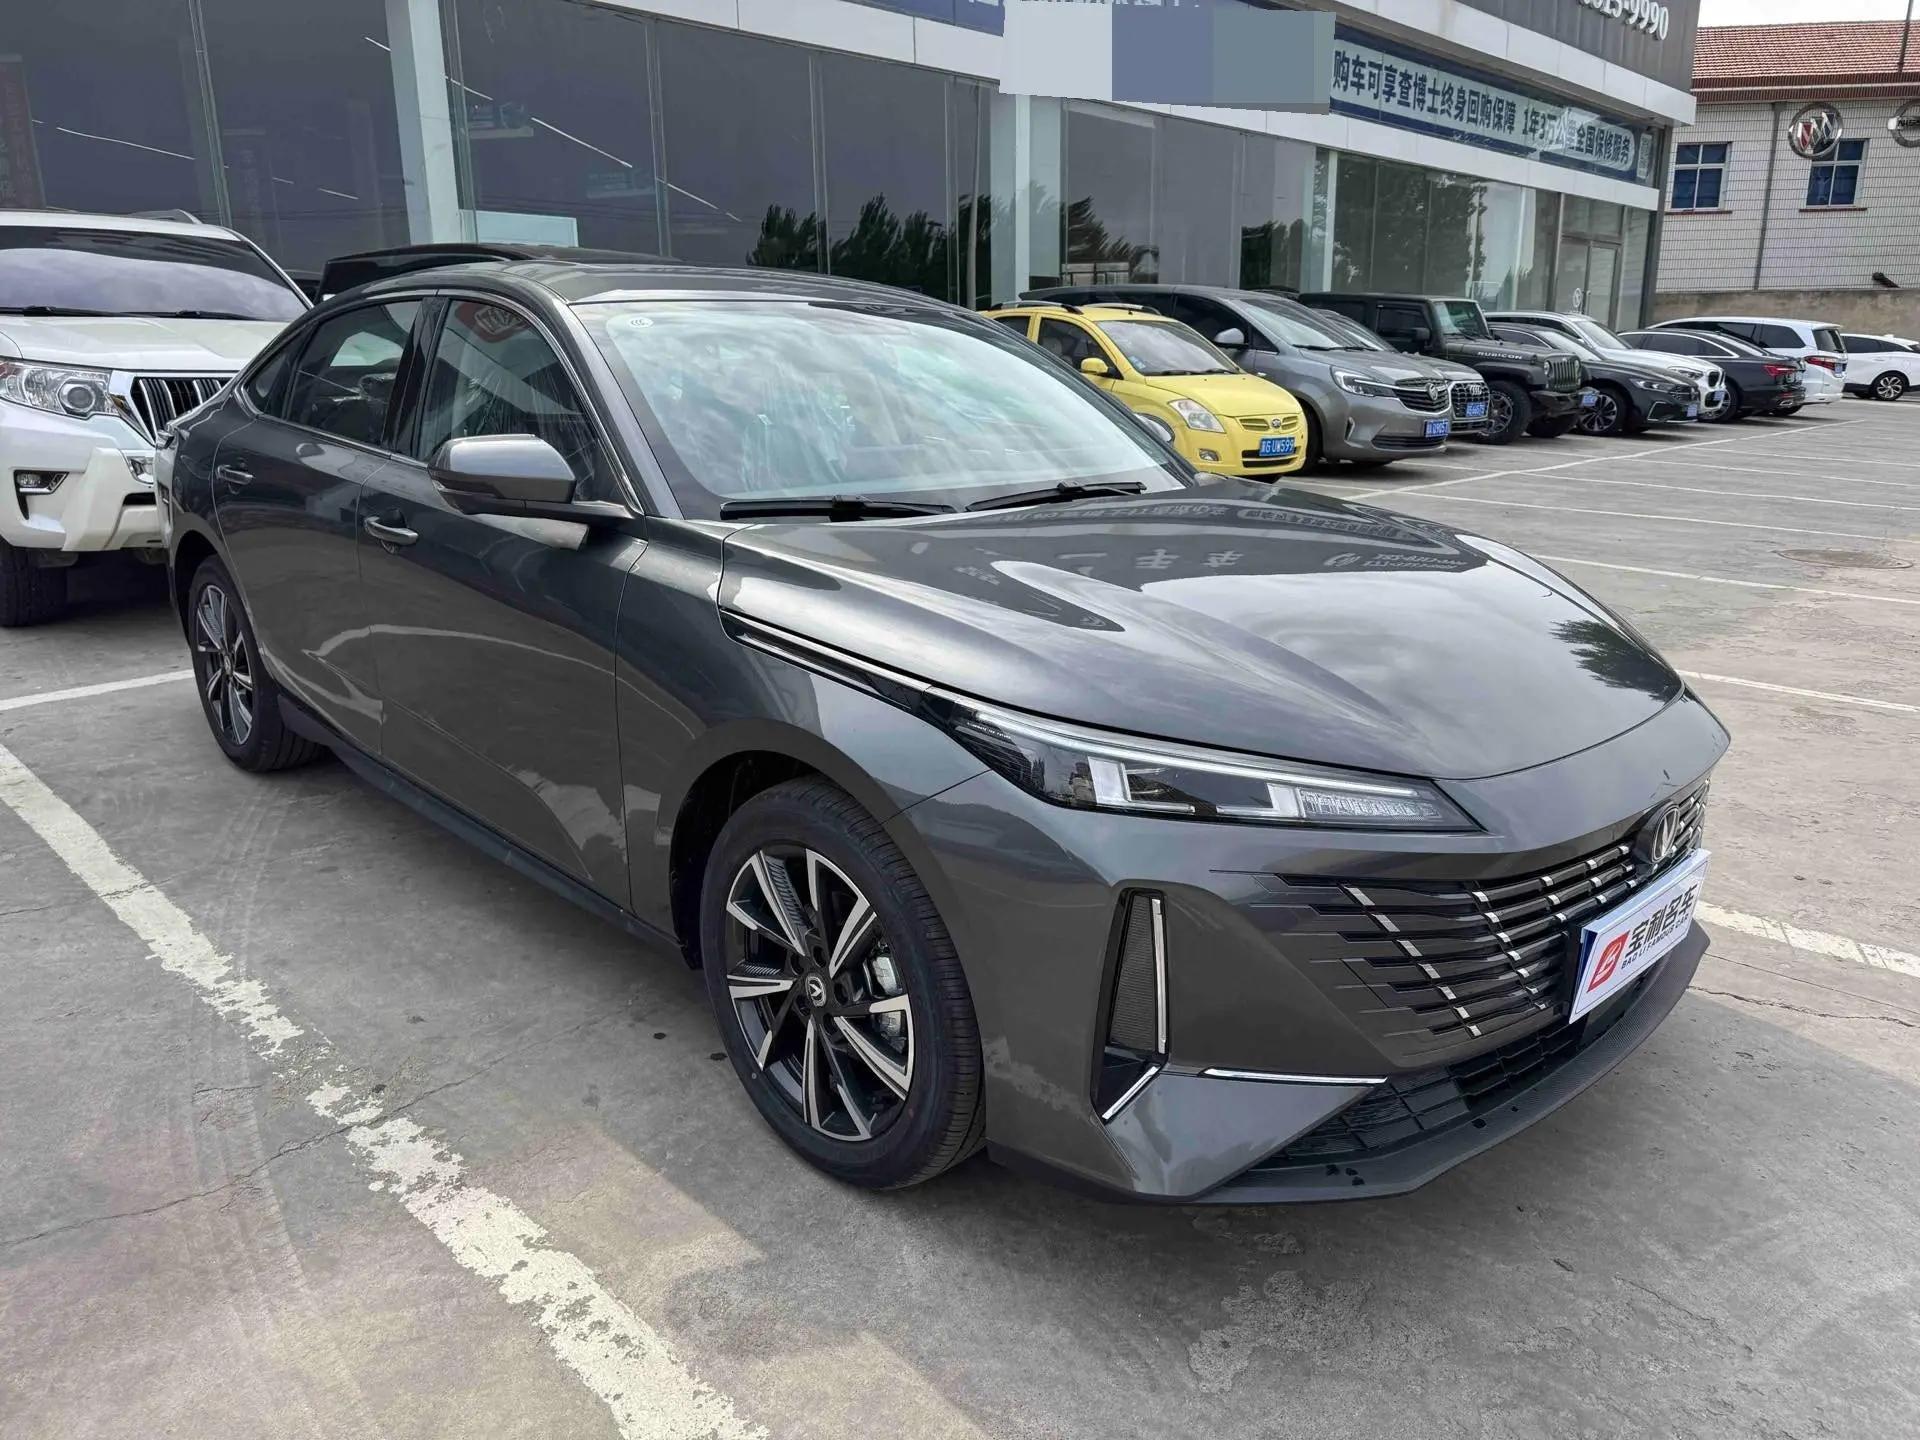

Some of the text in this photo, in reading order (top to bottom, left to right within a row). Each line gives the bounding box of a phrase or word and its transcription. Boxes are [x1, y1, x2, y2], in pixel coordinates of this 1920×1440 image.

[1332, 50, 1516, 134] 购车可享查博士终身回购保障
[1477, 351, 1523, 360] RUBICON
[1625, 884, 1697, 958] 宝利名车
